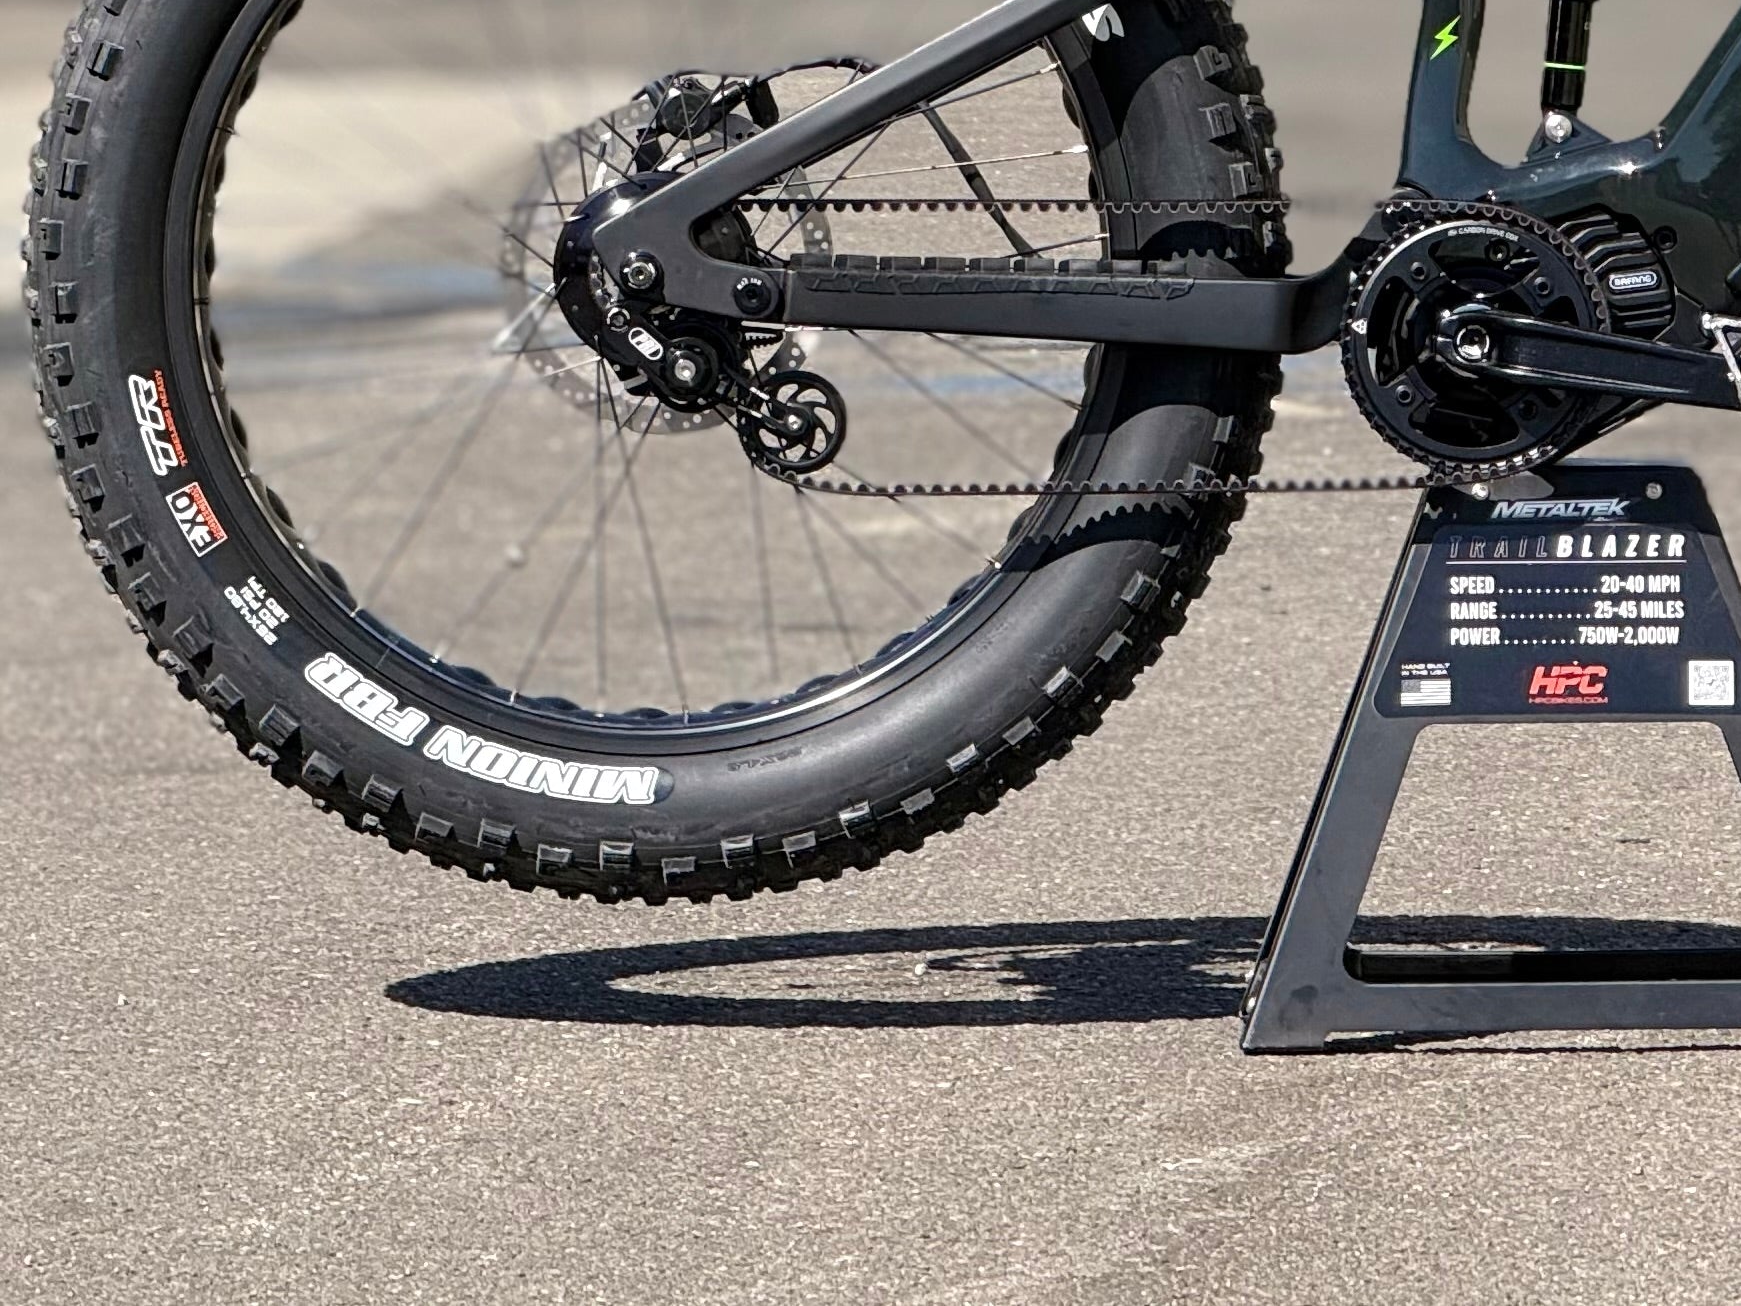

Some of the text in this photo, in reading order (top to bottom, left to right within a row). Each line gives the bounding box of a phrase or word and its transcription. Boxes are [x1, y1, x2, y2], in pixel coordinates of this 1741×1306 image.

[127, 374, 179, 477] TR
[170, 490, 213, 550] EXO
[1490, 497, 1631, 520] METALTEK
[247, 575, 290, 623] 120 TPI
[1450, 575, 1680, 594] SPEED 20-40 MPH
[240, 586, 280, 630] 20 PSI
[1450, 601, 1684, 620] RANGE 25-45 MILES
[1450, 626, 1679, 645] POWER 750W-2,000W
[1528, 665, 1609, 695] HPC
[304, 651, 660, 805] MINION FBR
